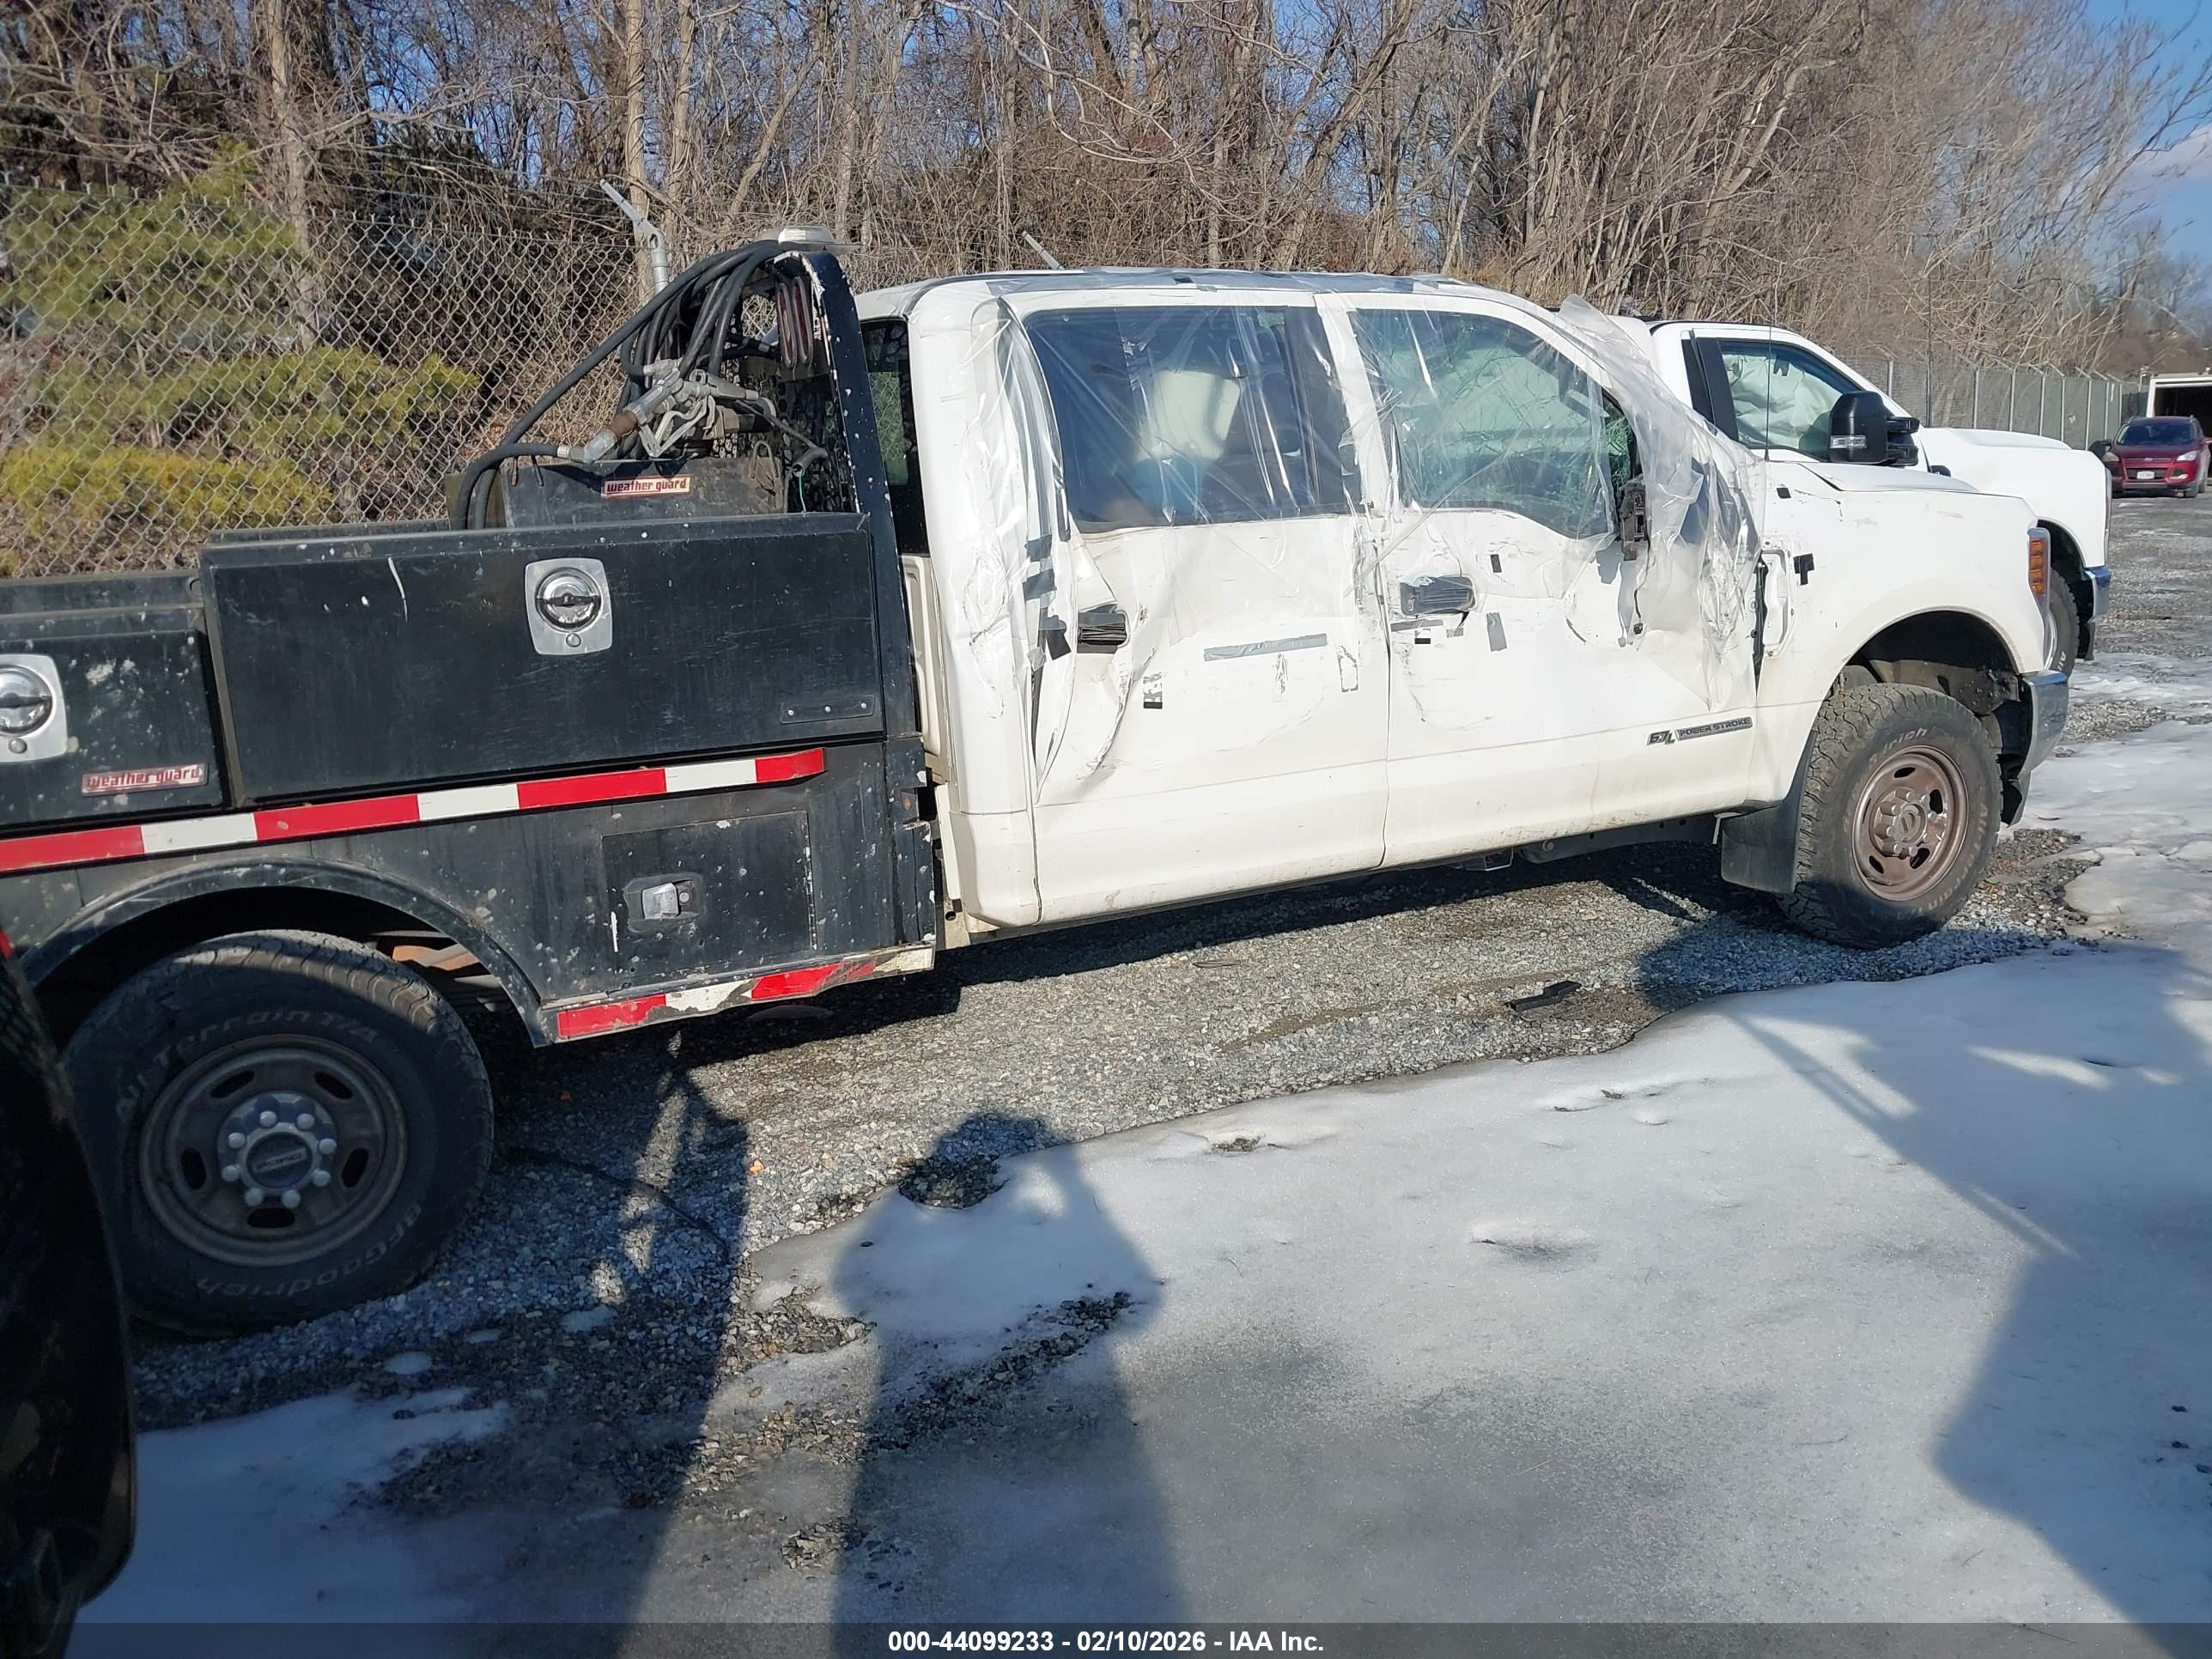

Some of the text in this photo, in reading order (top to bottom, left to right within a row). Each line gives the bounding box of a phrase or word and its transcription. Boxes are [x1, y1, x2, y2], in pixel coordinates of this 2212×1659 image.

[606, 478, 688, 493] weather guard
[1680, 725, 1711, 737] POWER
[1713, 718, 1751, 731] STROKE
[87, 766, 201, 788] weather guard
